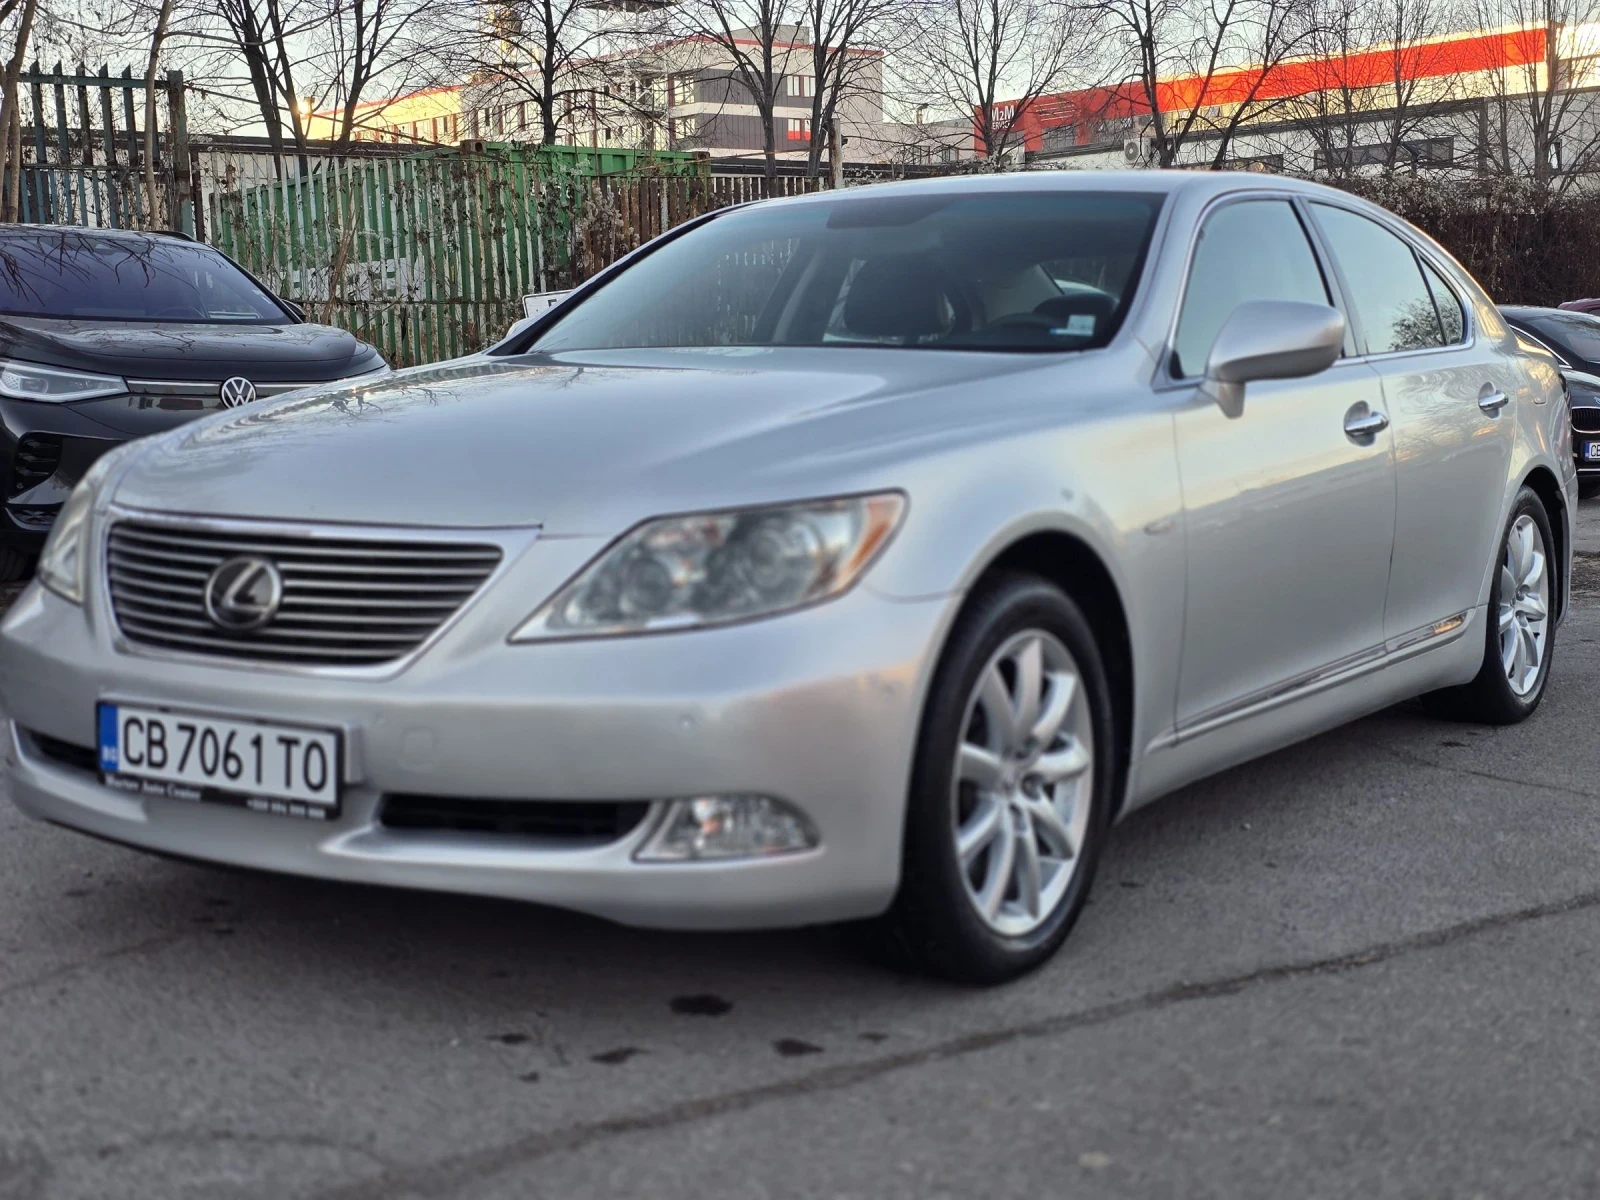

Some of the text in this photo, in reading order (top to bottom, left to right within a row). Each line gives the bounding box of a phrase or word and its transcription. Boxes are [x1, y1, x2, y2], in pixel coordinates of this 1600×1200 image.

[123, 715, 329, 793] CB 7061 TO
